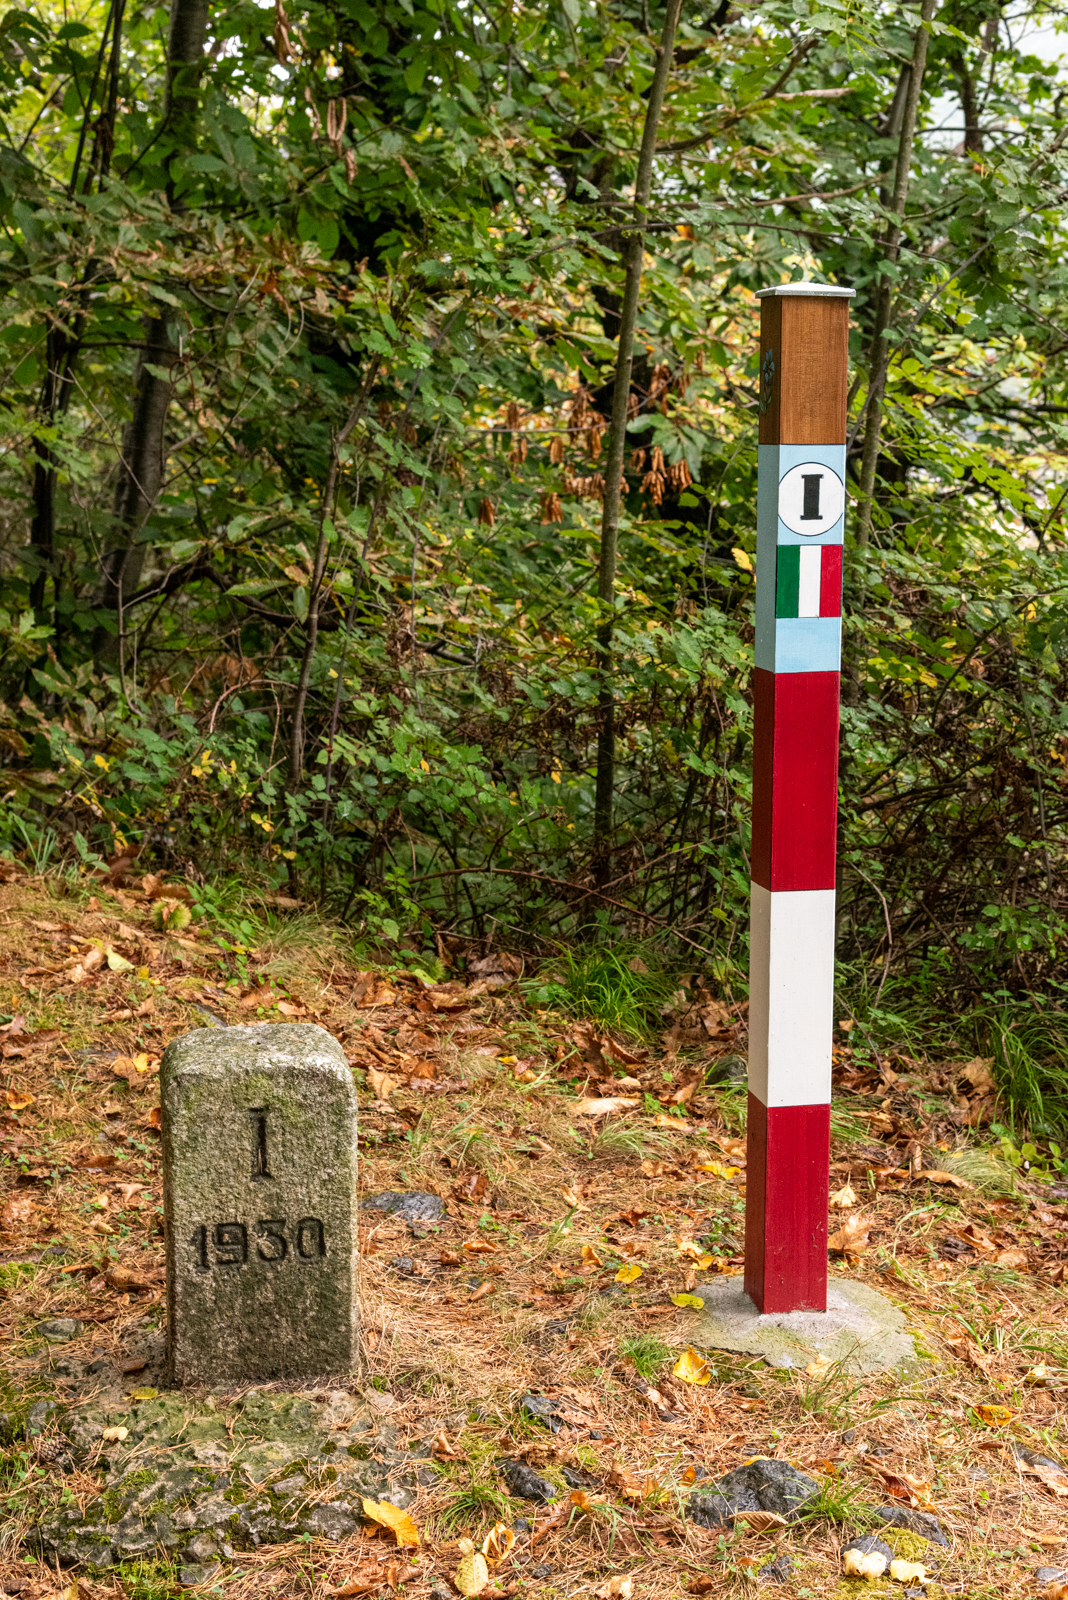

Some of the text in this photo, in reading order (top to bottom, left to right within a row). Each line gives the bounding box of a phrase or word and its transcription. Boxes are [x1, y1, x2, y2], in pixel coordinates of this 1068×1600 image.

[800, 473, 823, 520] I
[247, 1106, 273, 1182] I
[191, 1216, 327, 1273] 1930
